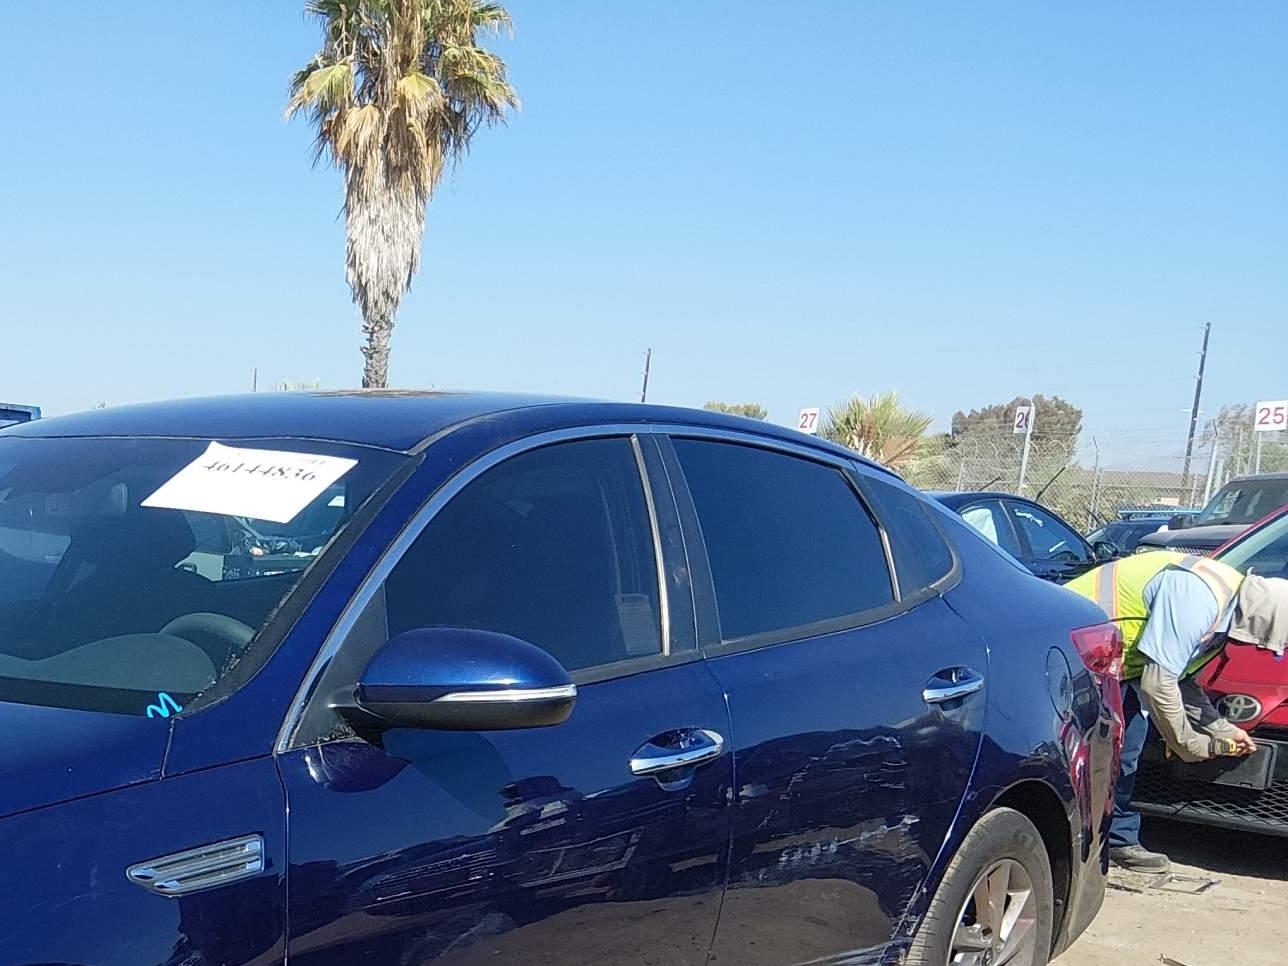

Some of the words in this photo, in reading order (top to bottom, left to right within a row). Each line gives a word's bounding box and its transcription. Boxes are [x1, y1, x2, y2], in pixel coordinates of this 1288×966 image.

[800, 413, 817, 428] 27
[1258, 407, 1285, 424] 25
[203, 461, 316, 481] 46144836
